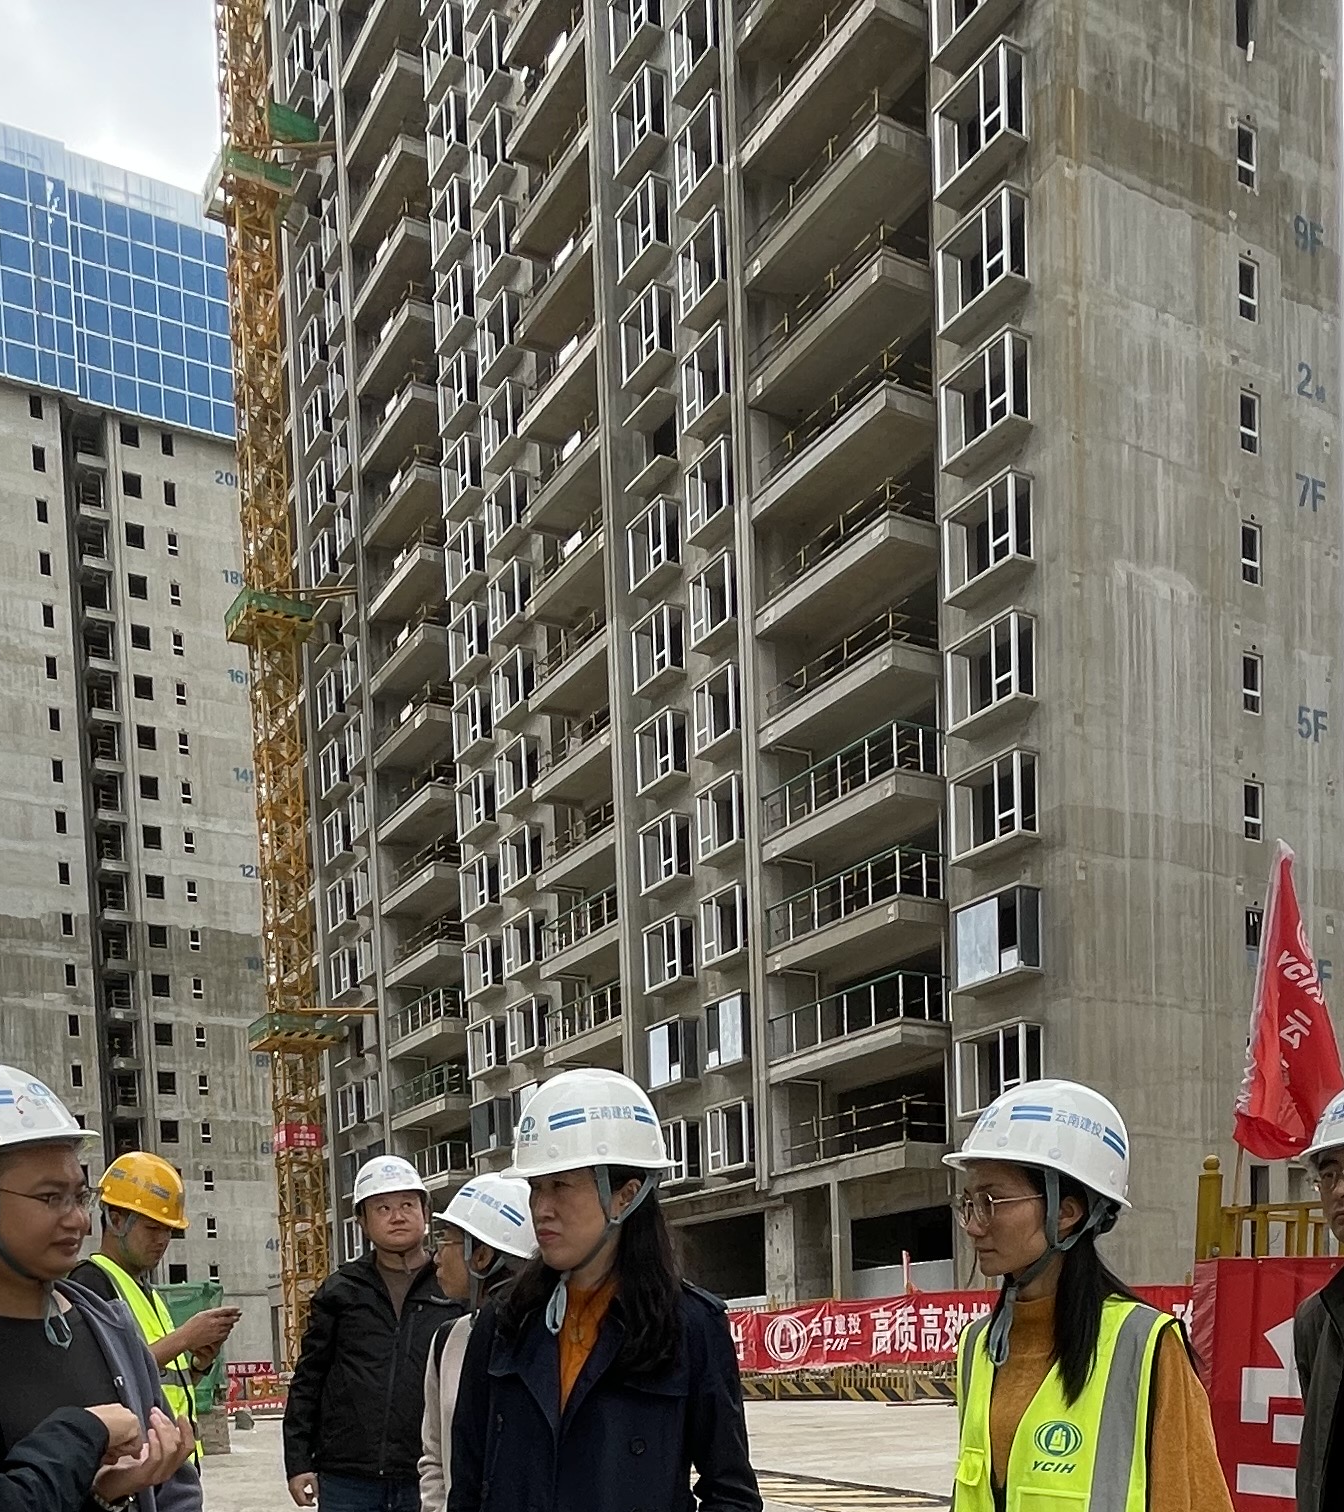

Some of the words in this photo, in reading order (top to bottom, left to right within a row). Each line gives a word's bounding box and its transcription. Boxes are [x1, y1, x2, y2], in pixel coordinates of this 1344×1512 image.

[1295, 474, 1327, 513] 7F
[1297, 706, 1328, 744] 5F
[1054, 1108, 1103, 1139] 云南建投
[1032, 1460, 1077, 1474] YCIH
